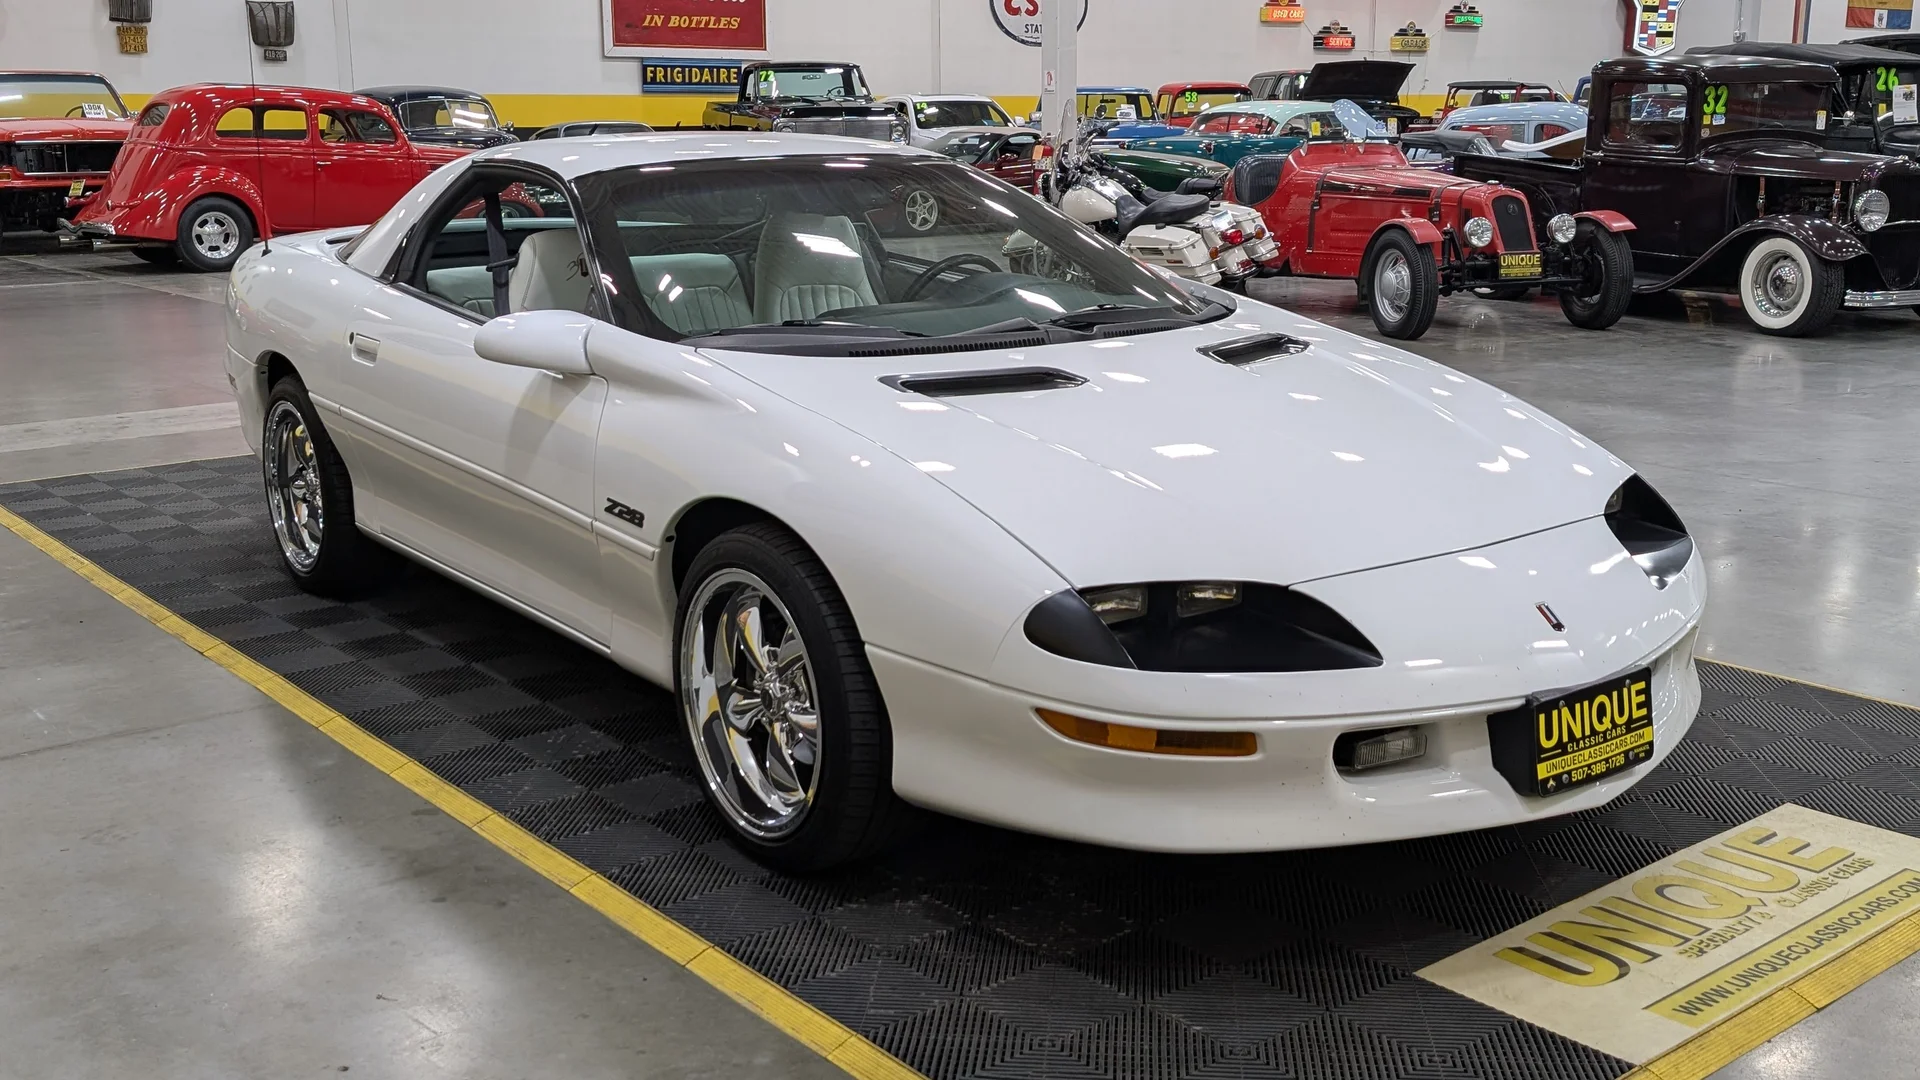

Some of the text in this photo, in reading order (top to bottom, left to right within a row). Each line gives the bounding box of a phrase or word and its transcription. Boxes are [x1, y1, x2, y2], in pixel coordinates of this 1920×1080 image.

[642, 14, 740, 29] IN BOTTLES
[1273, 9, 1304, 18] USED CARS
[1024, 23, 1042, 34] STAT
[1329, 37, 1352, 47] SERVICE
[646, 66, 738, 83] FRIGIDAIRE
[759, 70, 775, 82] 72
[1876, 66, 1899, 92] 26
[915, 102, 928, 110] 14
[1185, 91, 1198, 102] 58
[1703, 85, 1728, 114] 32
[1501, 254, 1540, 266] UNIQUE
[604, 497, 645, 529] Z28
[1538, 681, 1648, 750] UNIQUE
[1567, 725, 1627, 752] CLASSIC CARS
[1546, 731, 1645, 775] UNIQUECLASSICCARS.COM
[1571, 754, 1625, 782] 507-386-1726
[1493, 825, 1856, 988] UNIQUE
[1677, 911, 1760, 958] SPECIALTY
[1776, 875, 1839, 908] CLASSIC
